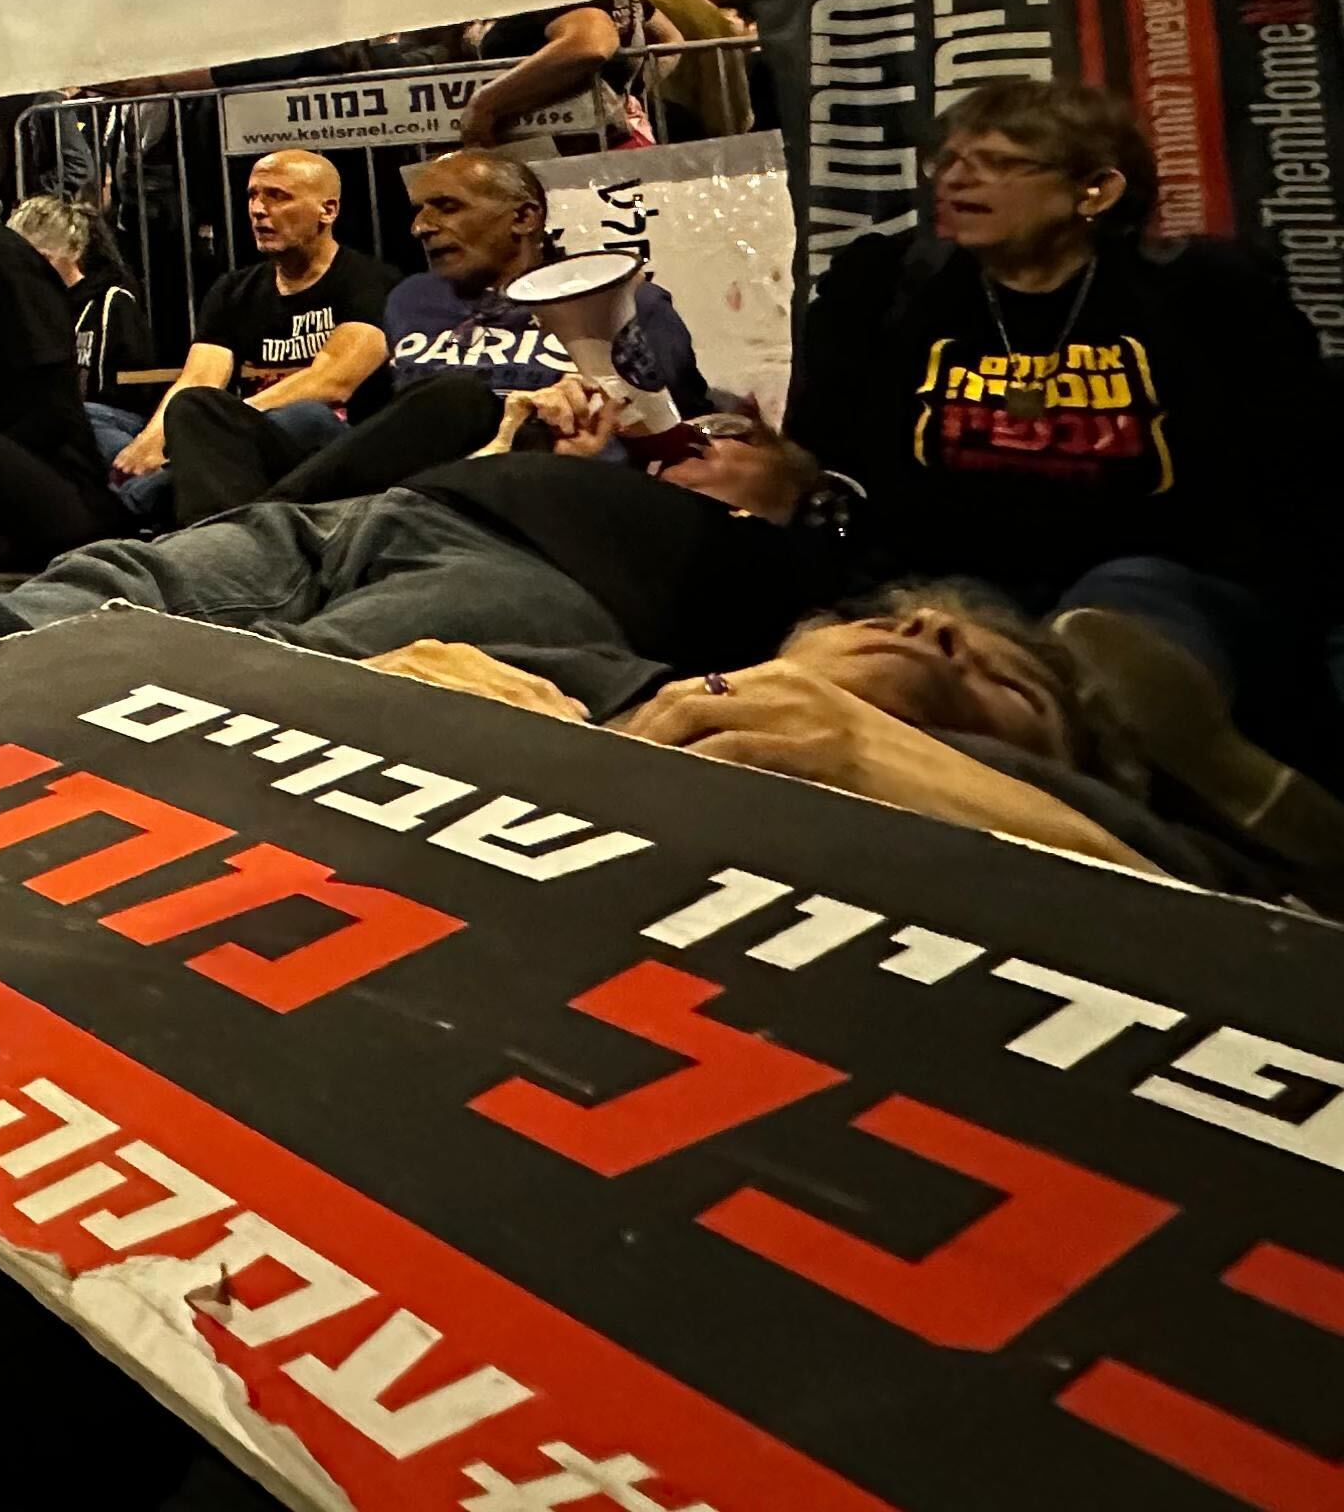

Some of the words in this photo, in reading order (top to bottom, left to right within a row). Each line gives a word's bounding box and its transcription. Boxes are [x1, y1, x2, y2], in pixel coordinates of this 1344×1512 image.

[286, 87, 389, 123] במות
[409, 77, 493, 114] שת
[390, 326, 579, 373] PARIS
[78, 684, 657, 882] שבויים
